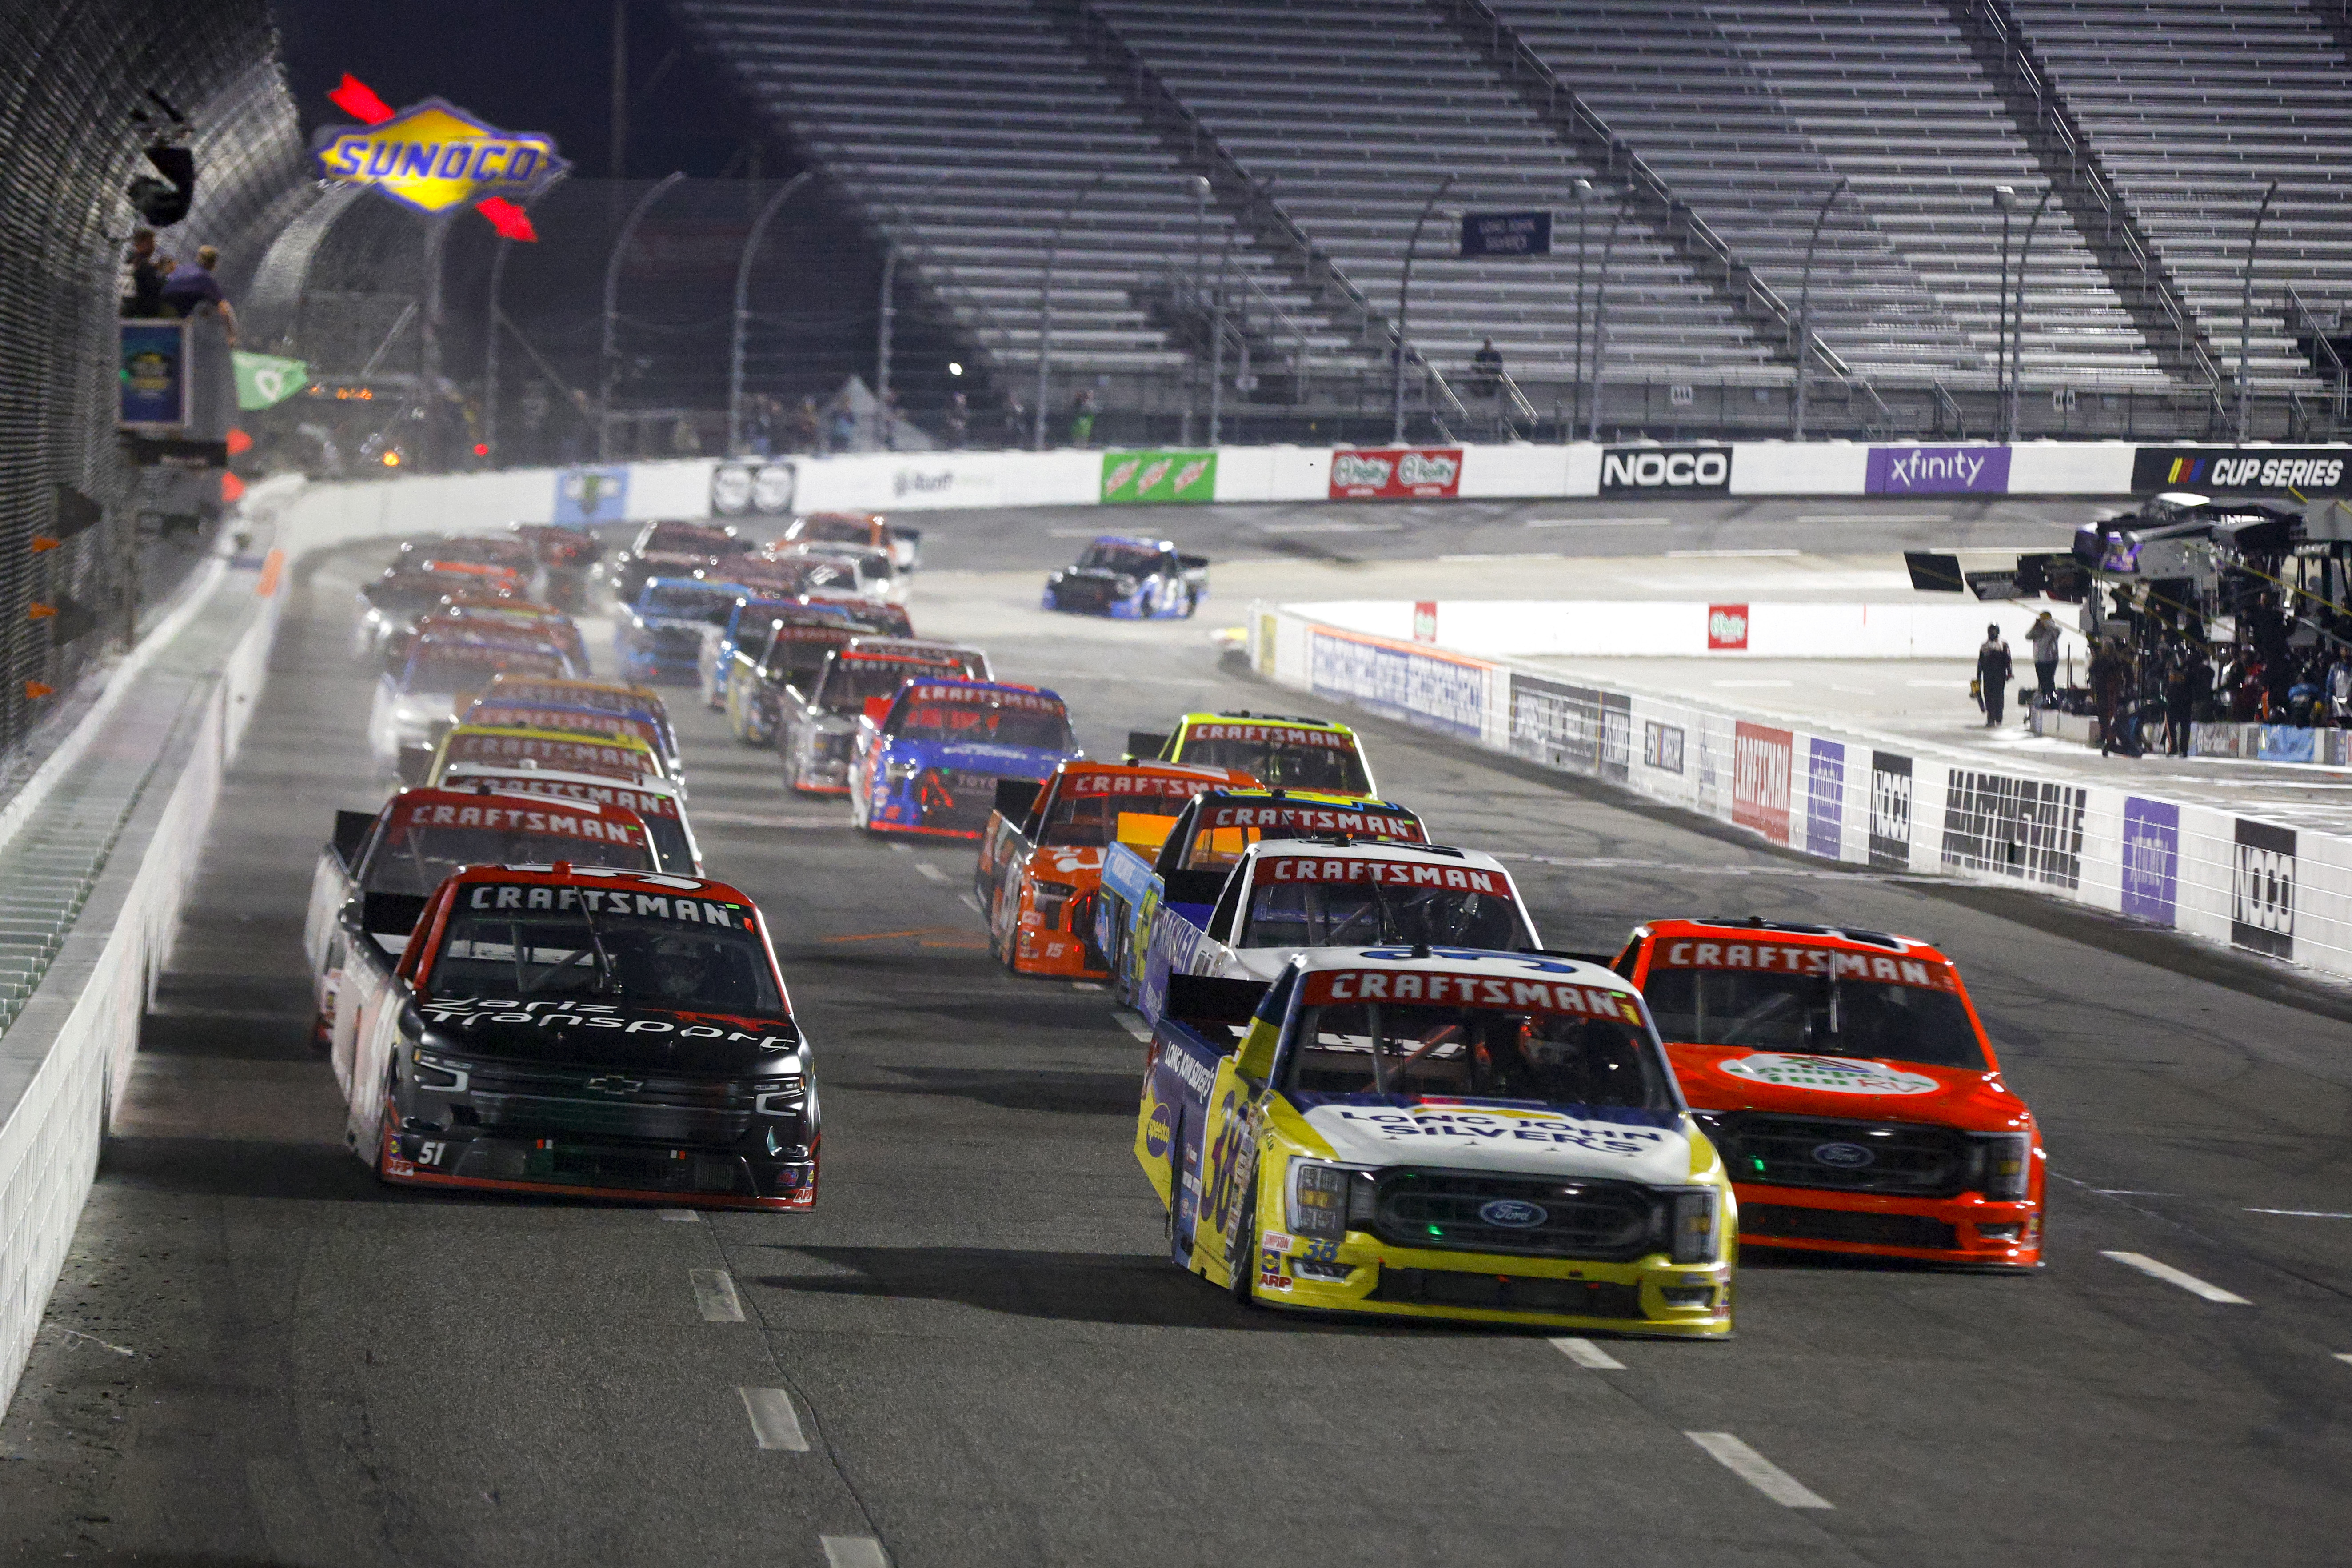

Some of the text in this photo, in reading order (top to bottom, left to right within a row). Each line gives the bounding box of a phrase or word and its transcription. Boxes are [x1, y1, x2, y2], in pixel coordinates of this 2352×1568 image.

[334, 140, 540, 180] SUNOCO
[1602, 452, 1728, 486] NOCO
[1891, 449, 1985, 487] xfinity
[2211, 458, 2344, 487] CUP SERIES
[1196, 725, 1340, 746] CRAFTSMAN
[1735, 735, 1789, 812] CRAFTSMAN
[1216, 808, 1408, 838] CRAFTSMAN
[1870, 769, 1911, 842] NOCO
[411, 804, 630, 844] CRAFTSMAN
[1275, 860, 1493, 892] CRAFTSMAN
[2233, 844, 2294, 933] NOCO
[471, 886, 731, 928] CRAFTSMAN
[1669, 942, 1931, 985] CRAFTSMAN
[1331, 973, 1622, 1017] CRAFTSMAN
[420, 1009, 796, 1051] Transport
[1165, 1041, 1183, 1073] LONG
[1178, 1052, 1196, 1082] JOHN
[1340, 1111, 1664, 1142] LONG JOHN
[1380, 1125, 1644, 1153] SILVER'S
[418, 1141, 446, 1165] 51
[1495, 1205, 1532, 1221] Ford
[1303, 1239, 1341, 1262] 38
[1258, 1273, 1293, 1292] ARP
